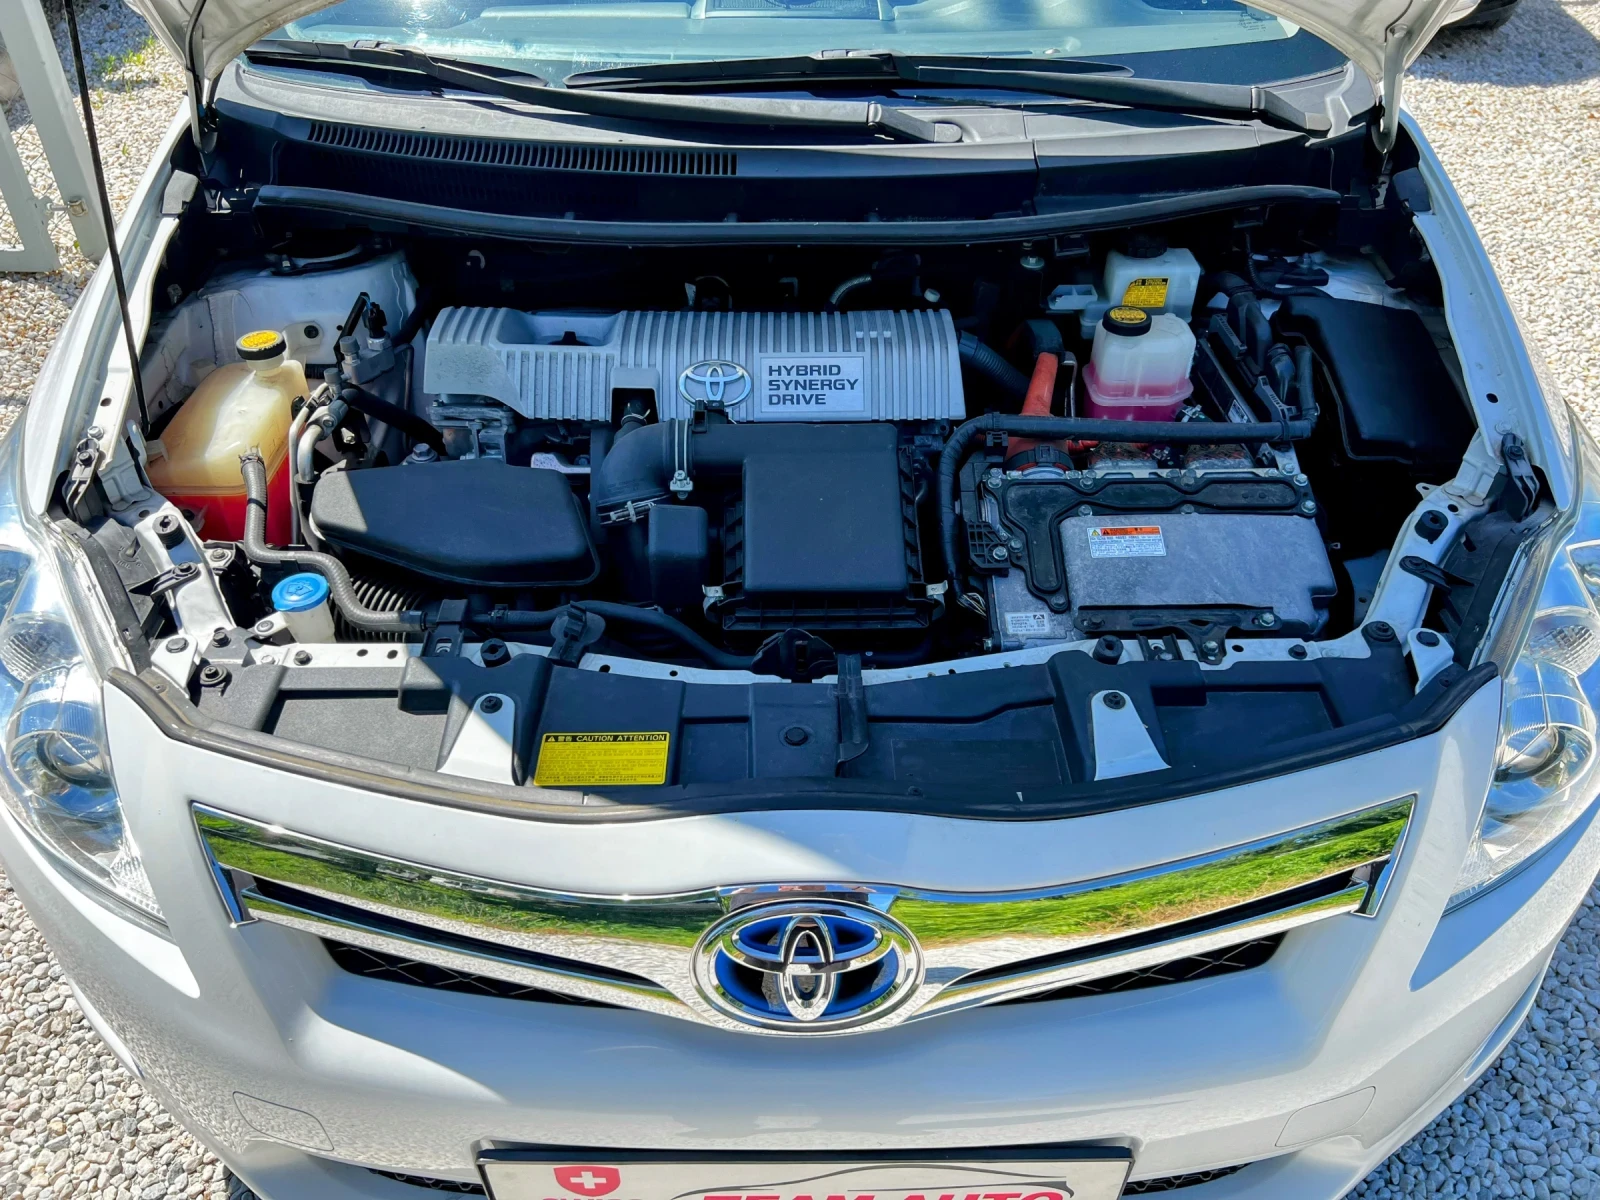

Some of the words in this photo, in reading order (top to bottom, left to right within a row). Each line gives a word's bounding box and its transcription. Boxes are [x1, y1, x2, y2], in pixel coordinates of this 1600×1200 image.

[768, 364, 842, 377] HYBRID
[768, 378, 860, 391] SYNERGY
[768, 393, 827, 406] DRIVE
[616, 734, 666, 742] ATTENTION
